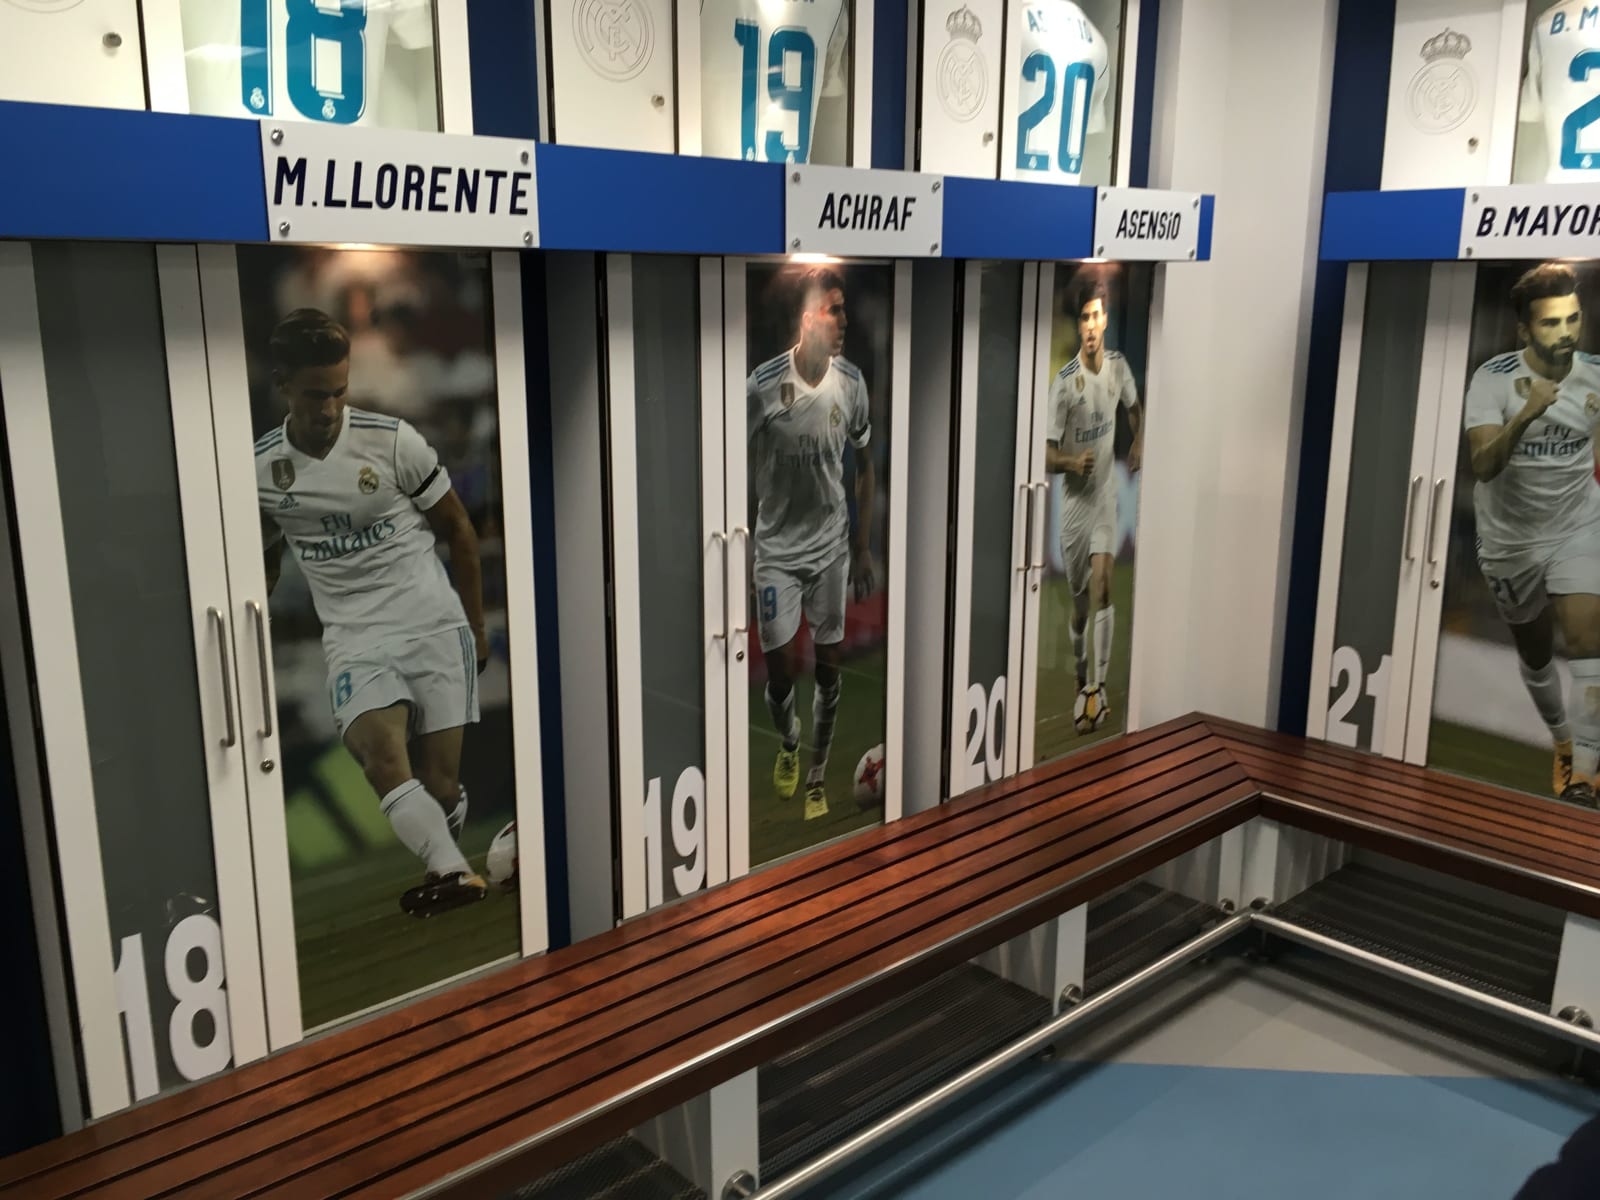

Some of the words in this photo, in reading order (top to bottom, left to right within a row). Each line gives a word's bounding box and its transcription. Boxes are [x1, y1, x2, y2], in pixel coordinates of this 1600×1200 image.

[241, 0, 367, 125] 18
[735, 19, 817, 164] 19
[1016, 50, 1095, 174] 20
[273, 156, 532, 216] M.LLORENTE
[818, 192, 917, 231] ACHRAF
[320, 511, 352, 532] Fly
[965, 675, 1006, 790] 20
[1326, 645, 1392, 755] 21
[644, 766, 705, 905] 19
[114, 913, 233, 1102] 18
